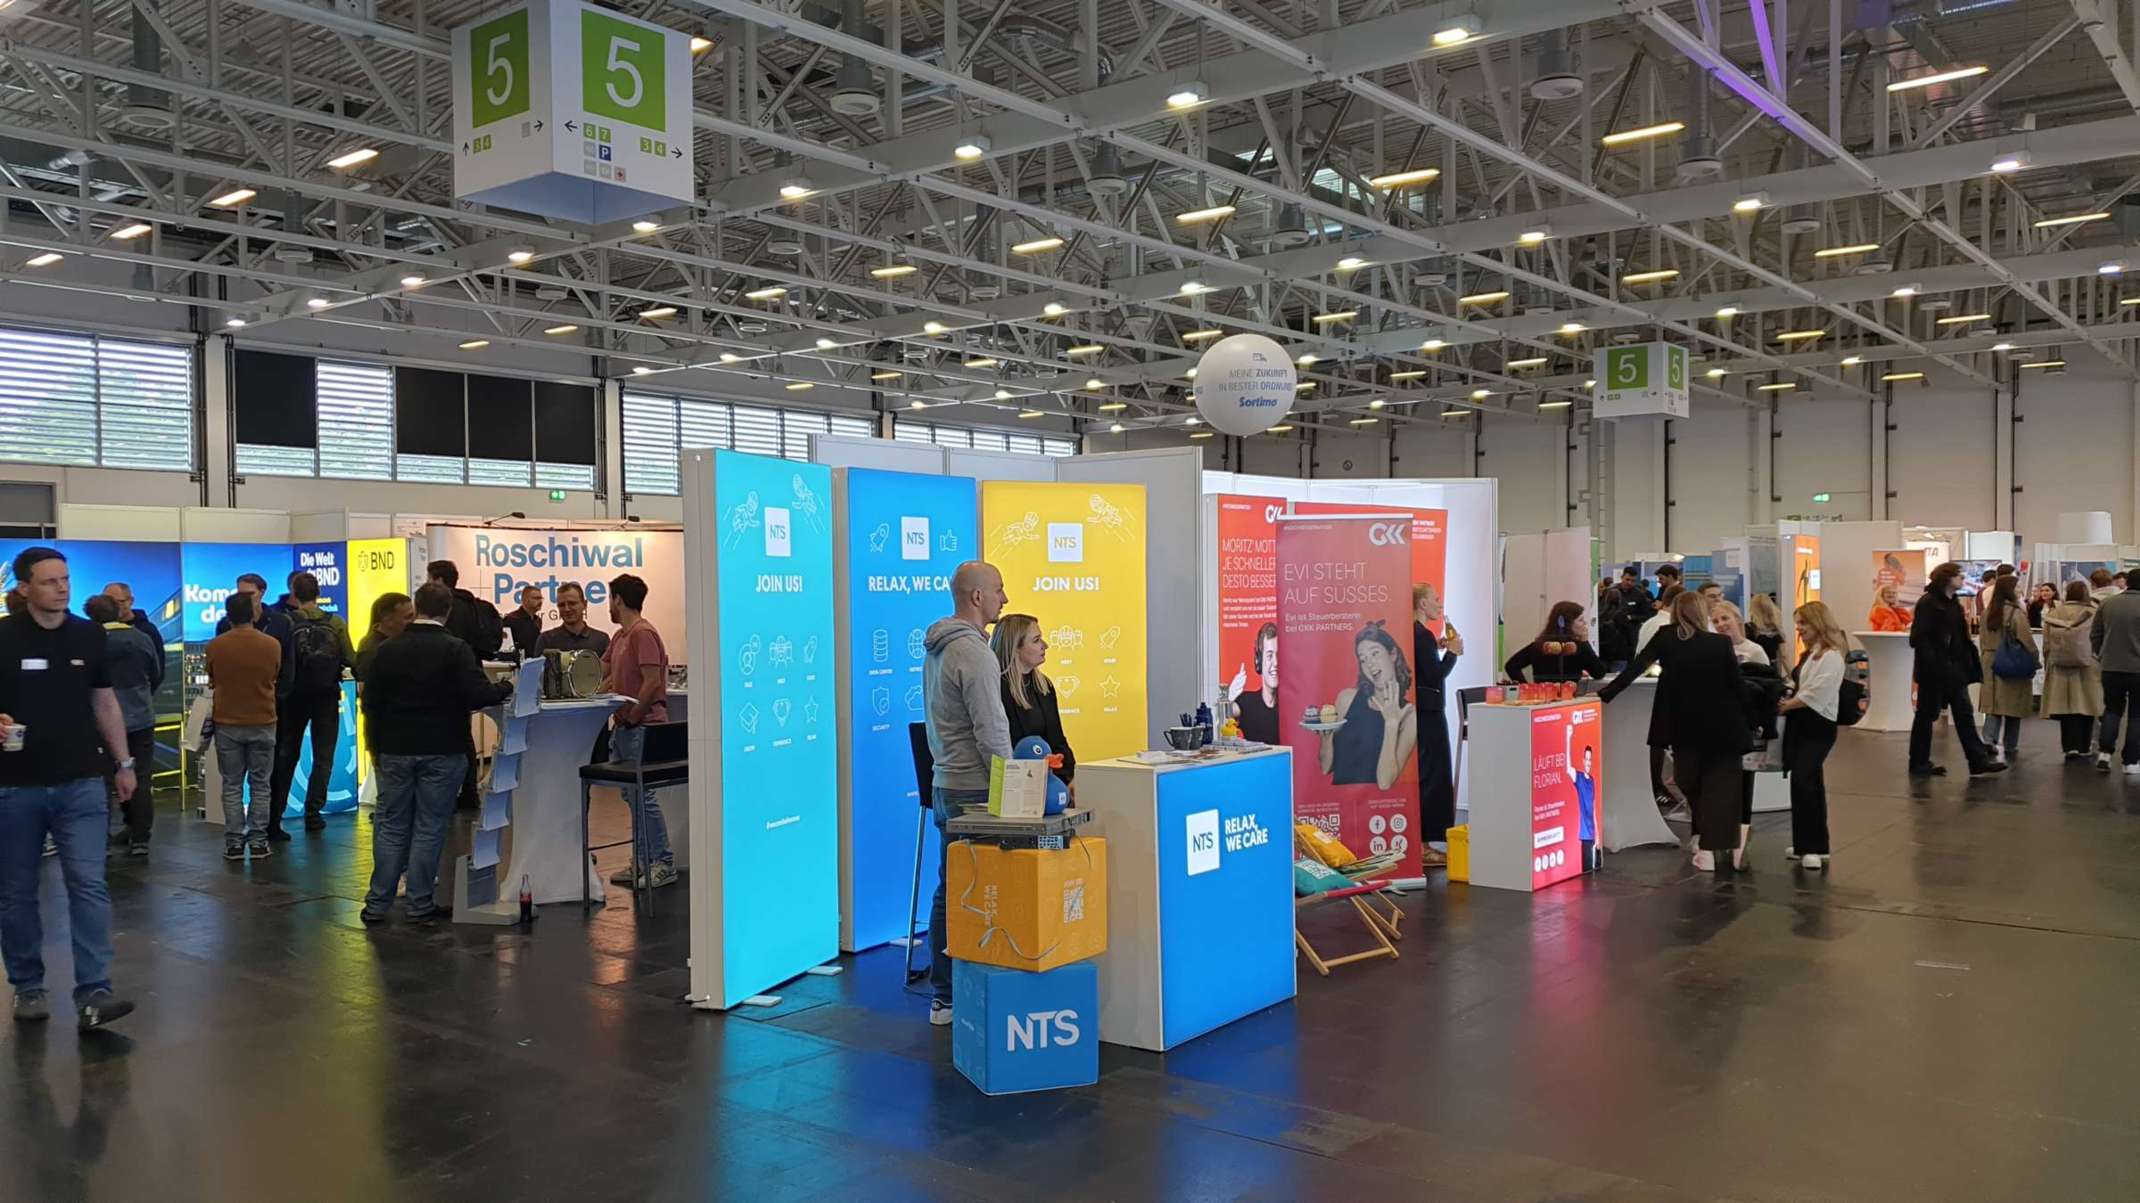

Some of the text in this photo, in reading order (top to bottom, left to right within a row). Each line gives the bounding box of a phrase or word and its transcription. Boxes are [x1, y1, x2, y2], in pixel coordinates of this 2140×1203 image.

[487, 33, 513, 106] 5
[606, 35, 644, 108] 5
[601, 147, 609, 158] P
[1256, 368, 1288, 378] ZUKUNFT
[1618, 354, 1637, 383] 5
[1672, 354, 1681, 383] 5
[1239, 396, 1278, 408] Sortimo
[769, 524, 786, 540] NTS
[906, 531, 925, 545] NTS
[475, 534, 643, 568] Roschiwal
[1053, 536, 1077, 549] NTS
[300, 551, 335, 567] Die Welt
[371, 551, 395, 570] BND
[1222, 574, 1249, 588] DESTO
[1284, 562, 1367, 581] EVI STEHT
[756, 574, 803, 592] JOIN US!
[868, 576, 911, 595] RELAX,
[912, 576, 931, 591] WE
[1032, 577, 1099, 592] JOIN US!
[184, 584, 238, 603] Kom
[1284, 586, 1320, 605] AUF
[1316, 623, 1353, 632] PARTNERS
[1225, 814, 1259, 835] RELAX,
[1193, 832, 1214, 853] NTS
[1226, 828, 1269, 853] WE CARE
[1007, 1009, 1080, 1052] NTS
